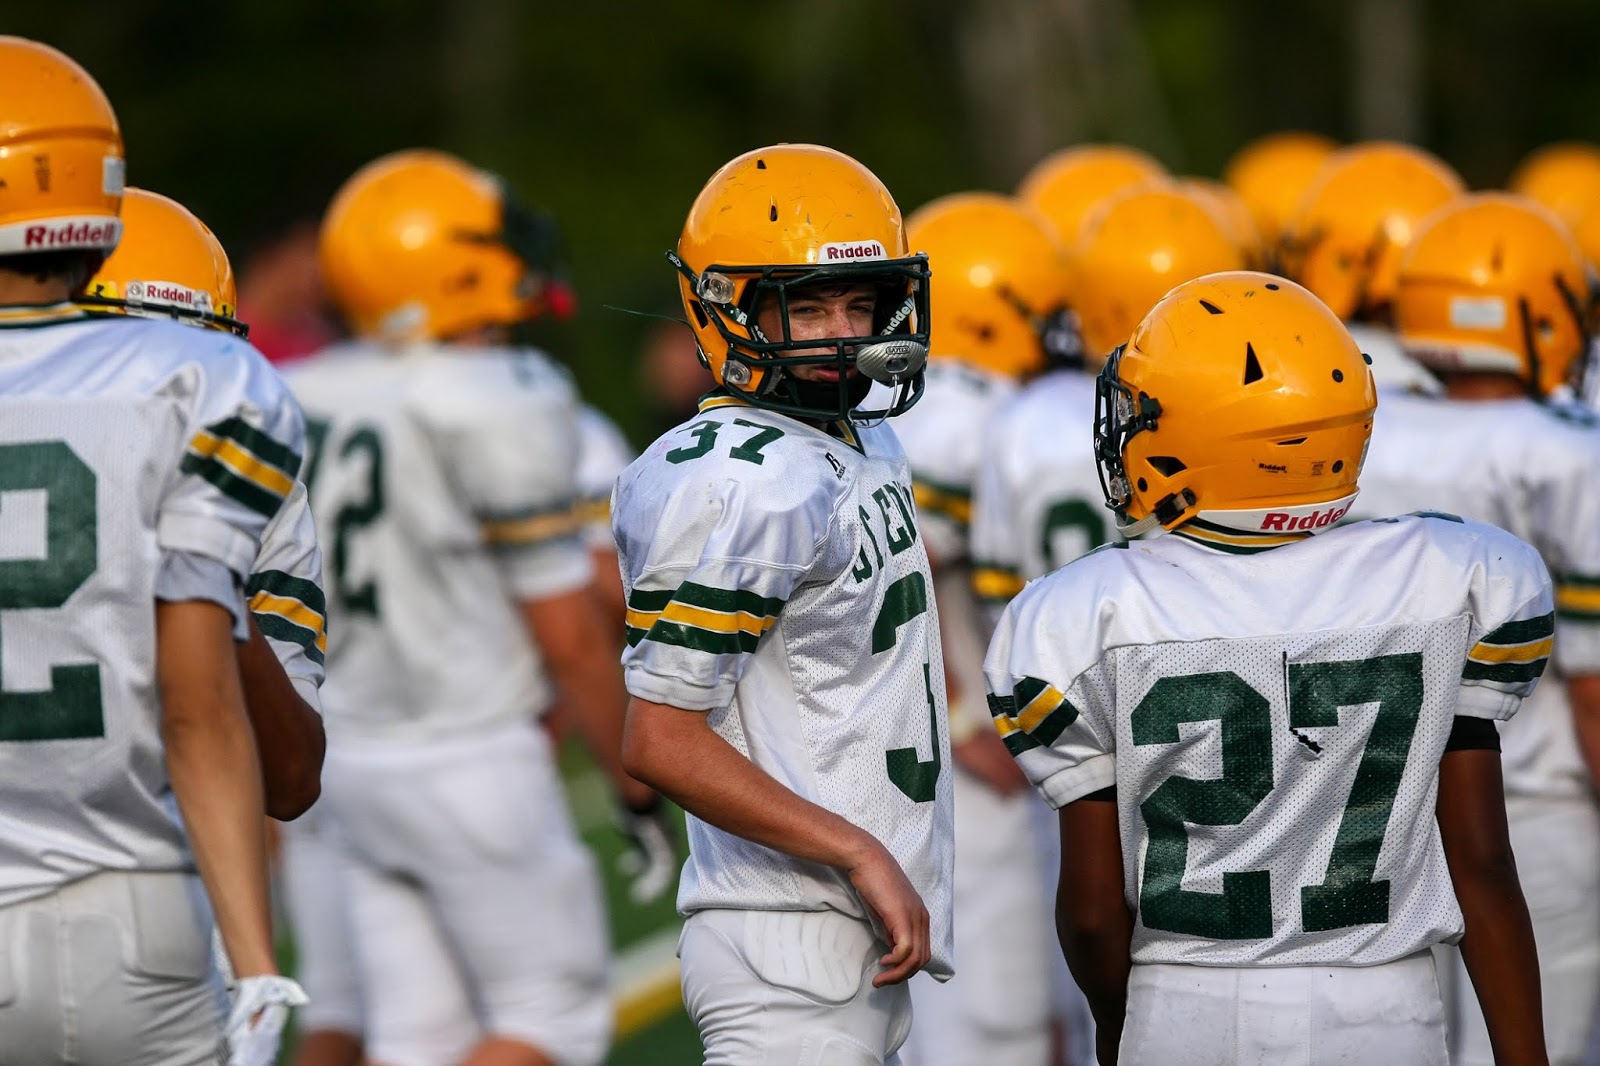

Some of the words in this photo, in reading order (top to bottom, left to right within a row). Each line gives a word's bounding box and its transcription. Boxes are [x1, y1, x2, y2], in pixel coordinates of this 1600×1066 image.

[25, 222, 114, 247] Riddell
[826, 243, 881, 260] Riddell
[146, 285, 193, 304] Riddell
[665, 418, 785, 465] 37
[1130, 652, 1424, 940] 27
